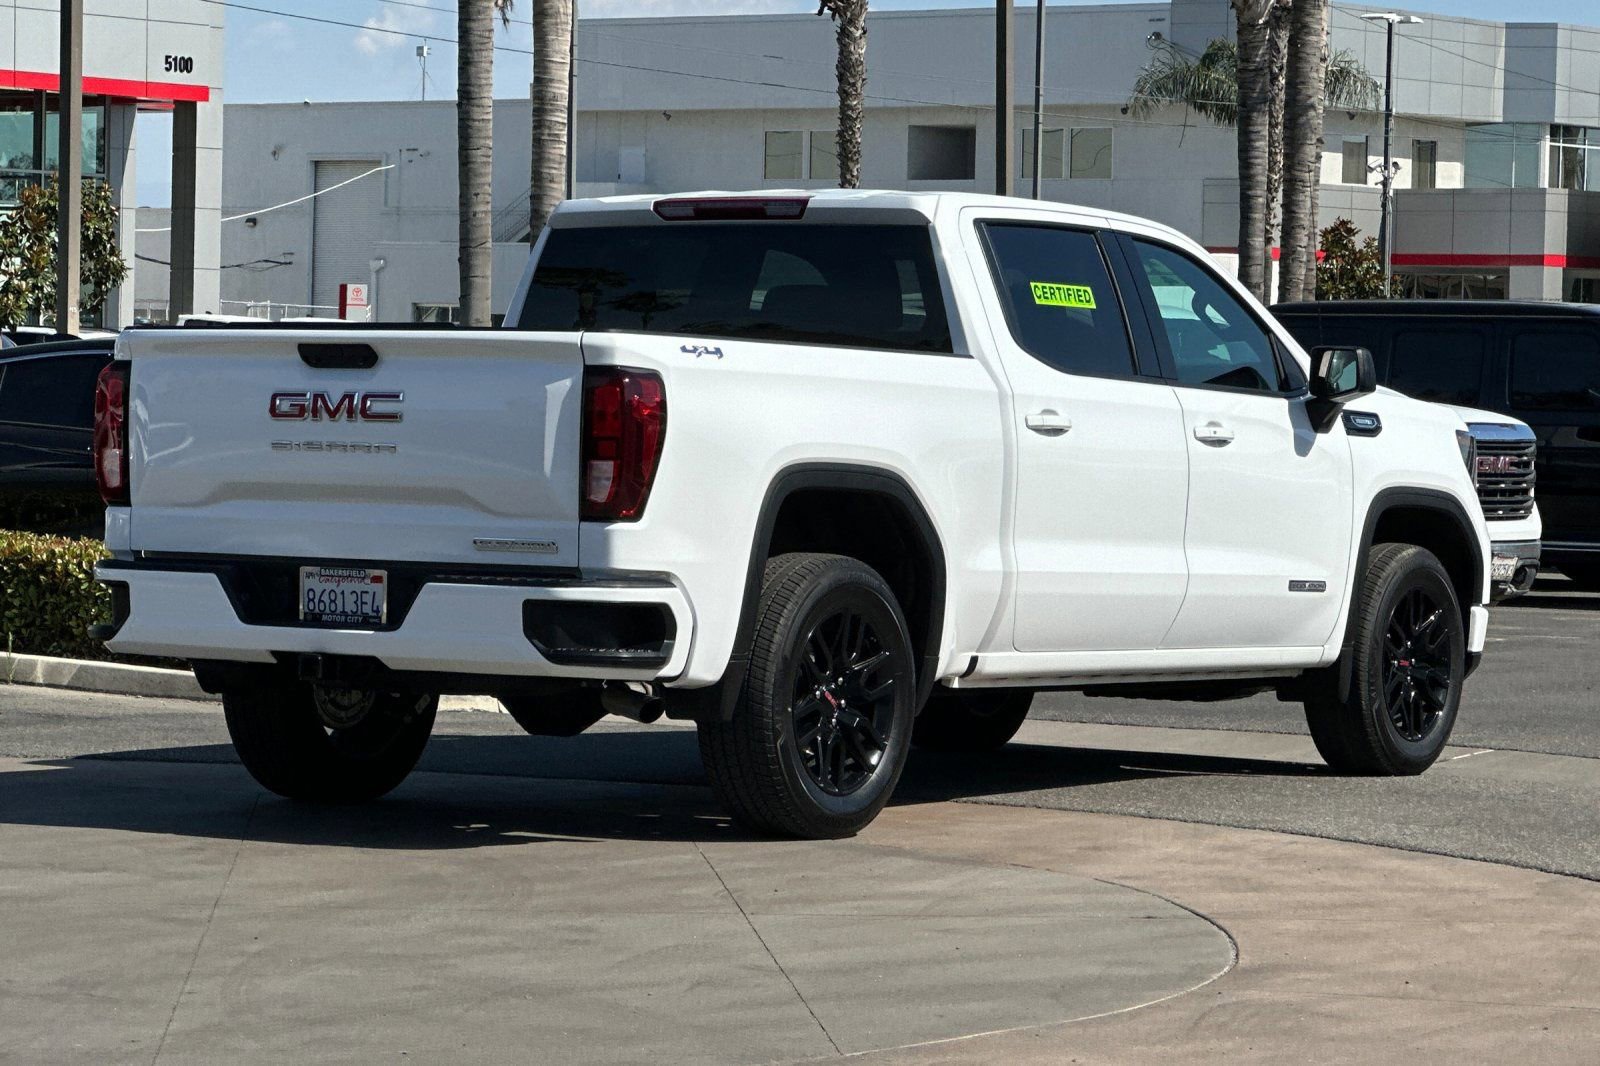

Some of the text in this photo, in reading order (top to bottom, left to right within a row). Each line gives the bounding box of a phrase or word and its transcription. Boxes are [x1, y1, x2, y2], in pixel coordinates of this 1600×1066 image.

[164, 54, 193, 74] 5100
[1033, 284, 1092, 304] CERTIFIED
[269, 391, 404, 422] GMC
[271, 440, 397, 454] SIERRA
[1476, 455, 1519, 474] GMC
[320, 568, 366, 577] BAKERSFIELD
[306, 588, 381, 617] 86813E4
[321, 614, 345, 622] MOTOR
